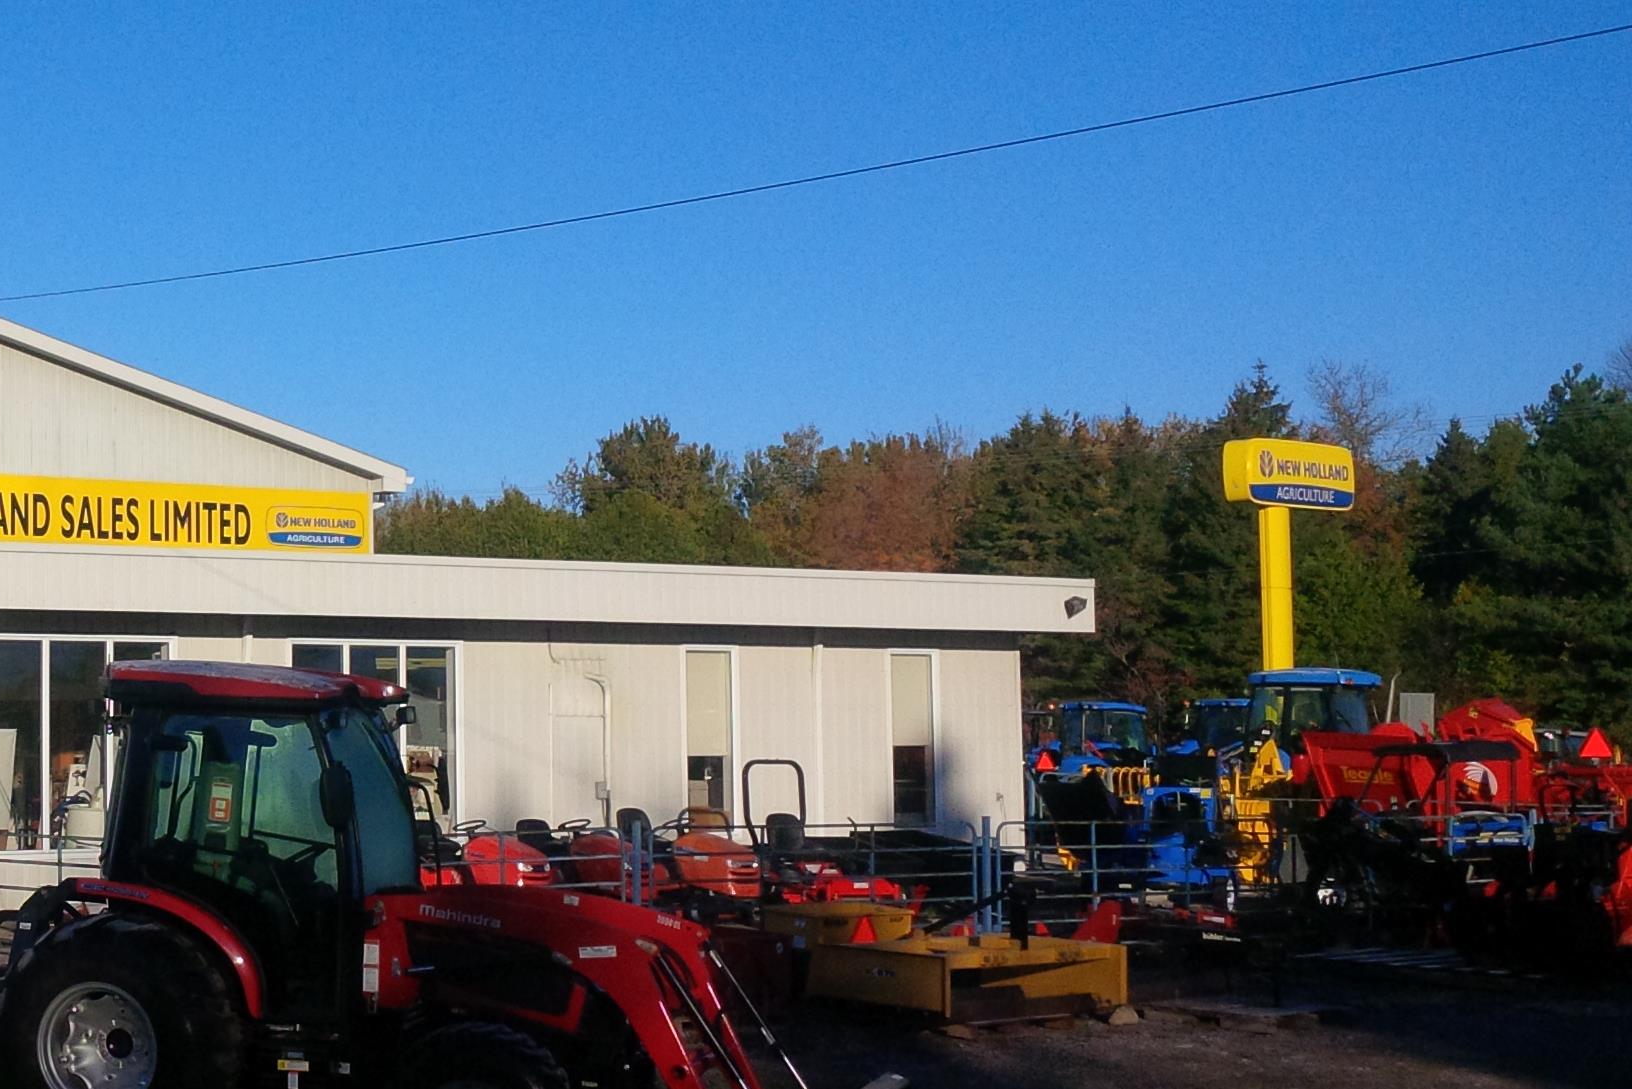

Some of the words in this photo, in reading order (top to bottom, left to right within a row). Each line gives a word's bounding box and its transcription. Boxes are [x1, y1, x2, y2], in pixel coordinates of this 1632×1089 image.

[1276, 459, 1300, 477] NEW
[1304, 461, 1348, 481] HOLLAND
[1276, 486, 1335, 503] AGRICULTURE
[60, 494, 139, 542] SALES
[150, 499, 252, 545] LIMITED
[289, 516, 312, 527] NEW
[314, 518, 356, 529] HOLLAND
[287, 534, 345, 544] AGRICULTURE
[419, 903, 501, 929] Mahindra
